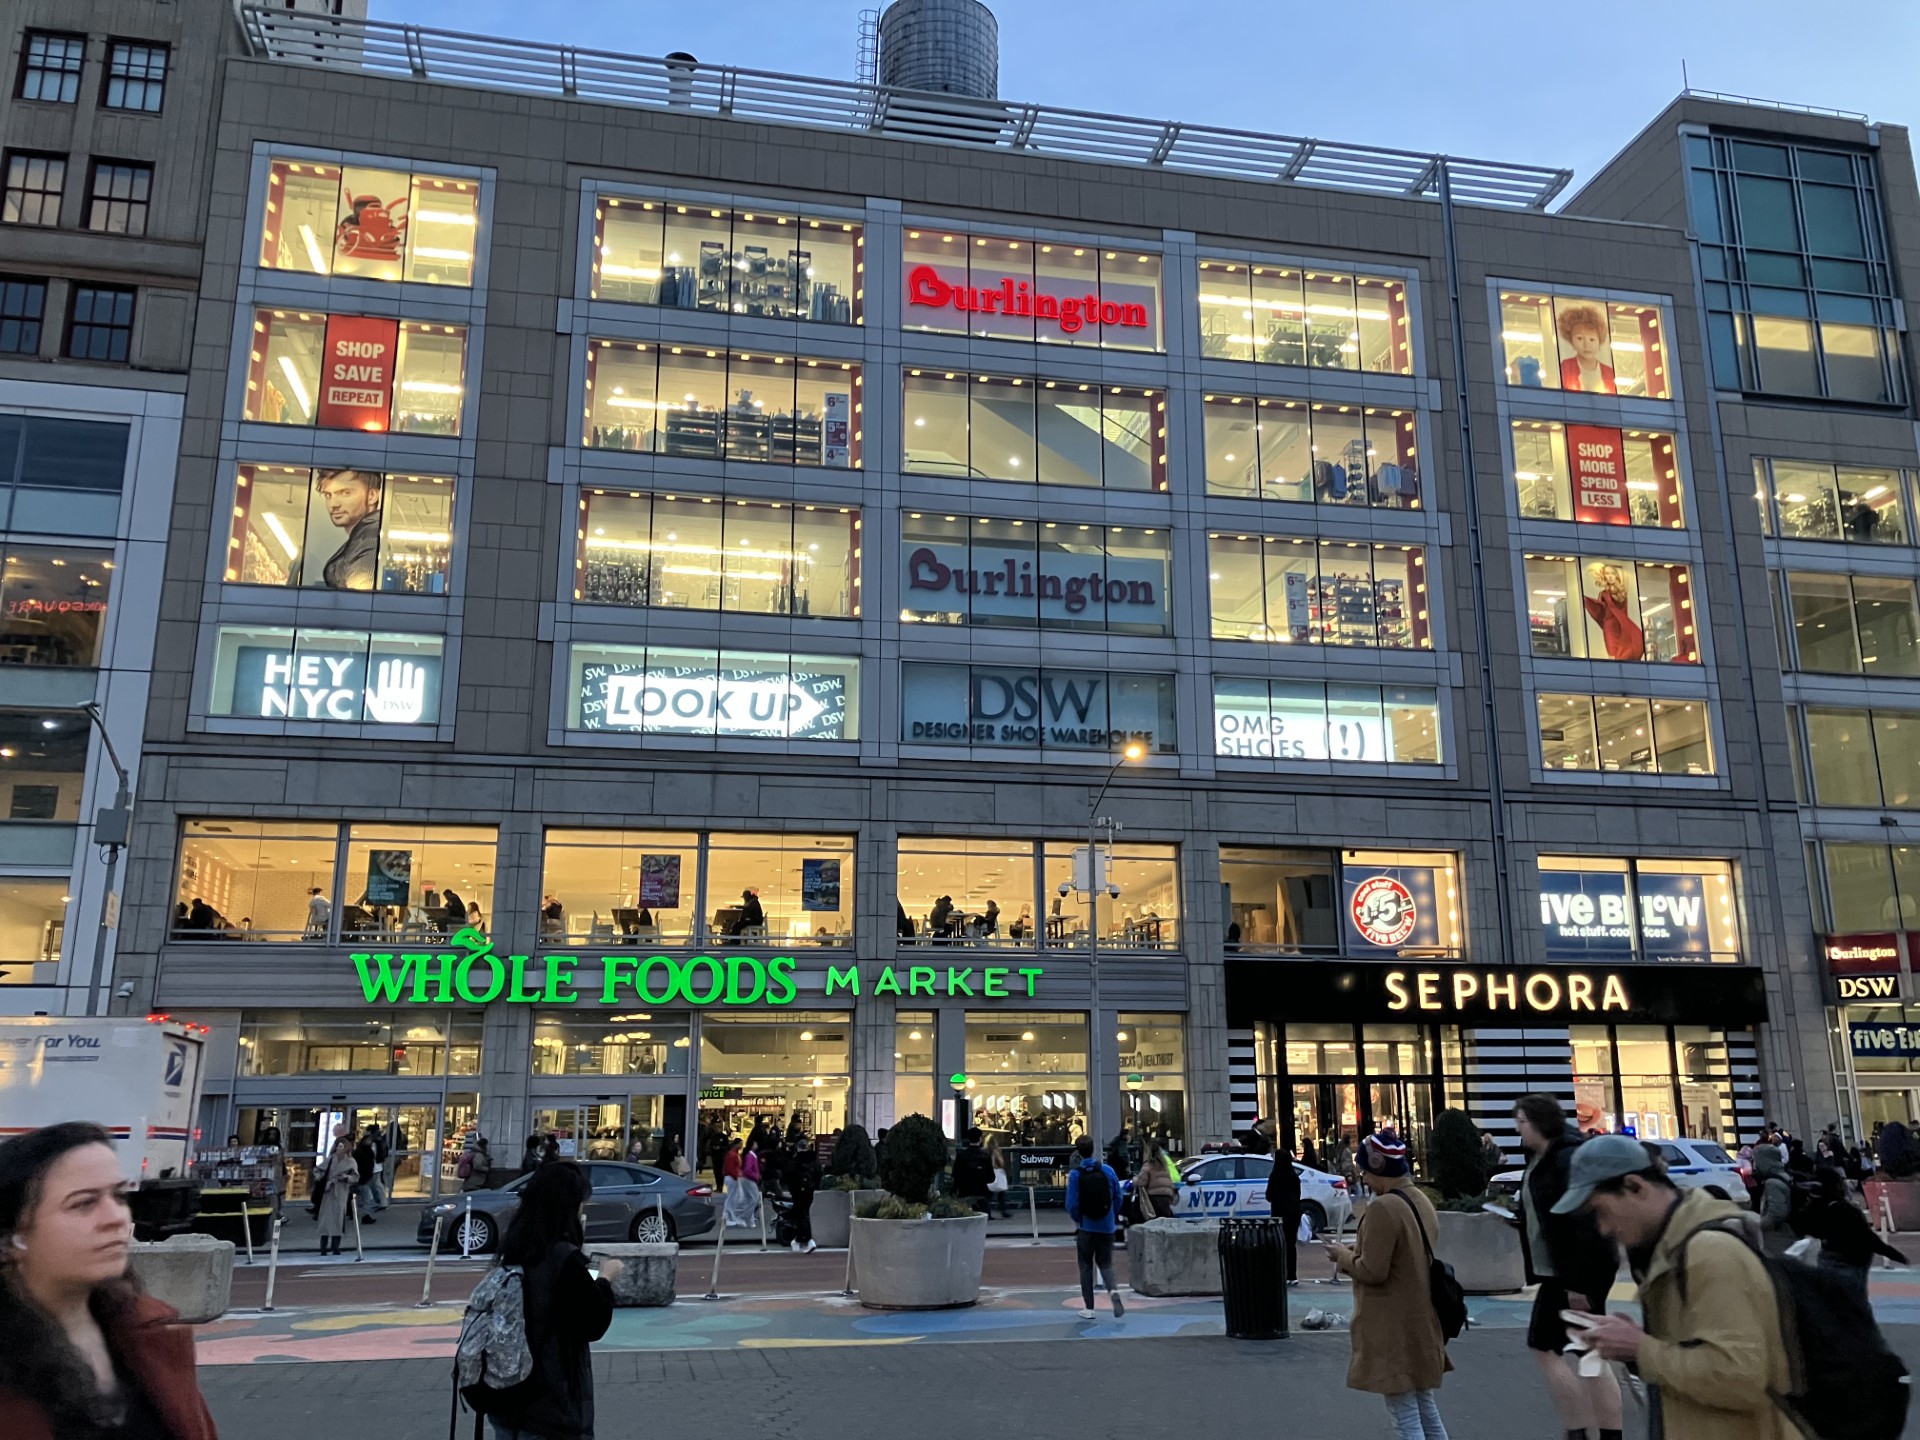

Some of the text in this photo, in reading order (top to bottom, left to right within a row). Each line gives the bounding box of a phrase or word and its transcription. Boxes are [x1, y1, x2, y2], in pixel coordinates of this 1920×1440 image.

[909, 264, 1148, 332] Burlington
[336, 340, 385, 359] SHOP
[333, 364, 383, 383] SAVE
[332, 390, 380, 404] REPEAT
[827, 396, 836, 408] 6
[827, 422, 836, 433] 5
[826, 449, 836, 460] 4
[1578, 443, 1614, 458] SHOP
[1580, 459, 1616, 474] MORE
[1581, 476, 1618, 490] SPEND
[1587, 493, 1615, 506] LESS
[909, 547, 1156, 613] Burlington
[264, 654, 354, 687] HEY
[812, 678, 842, 694] DSW.
[261, 686, 354, 720] NYC
[383, 700, 414, 711] DSW
[613, 686, 802, 721] LOOK UP
[971, 674, 1101, 723] DSW
[912, 721, 1153, 745] DESIGNER SHOE WAREHOUSE
[1220, 714, 1285, 735] OMG
[1221, 737, 1305, 759] SHOES
[1540, 893, 1595, 926] ive
[1560, 926, 1579, 937] hot
[1580, 926, 1608, 937] stuff.
[1830, 946, 1897, 961] Burlington
[350, 946, 1043, 1005] WHOLE FOODS MARKET
[1385, 971, 1630, 1011] SEPHORA
[1838, 976, 1896, 998] DSW
[1853, 1028, 1896, 1050] five
[1020, 1155, 1055, 1165] Subway
[1187, 1190, 1237, 1208] NYPD
